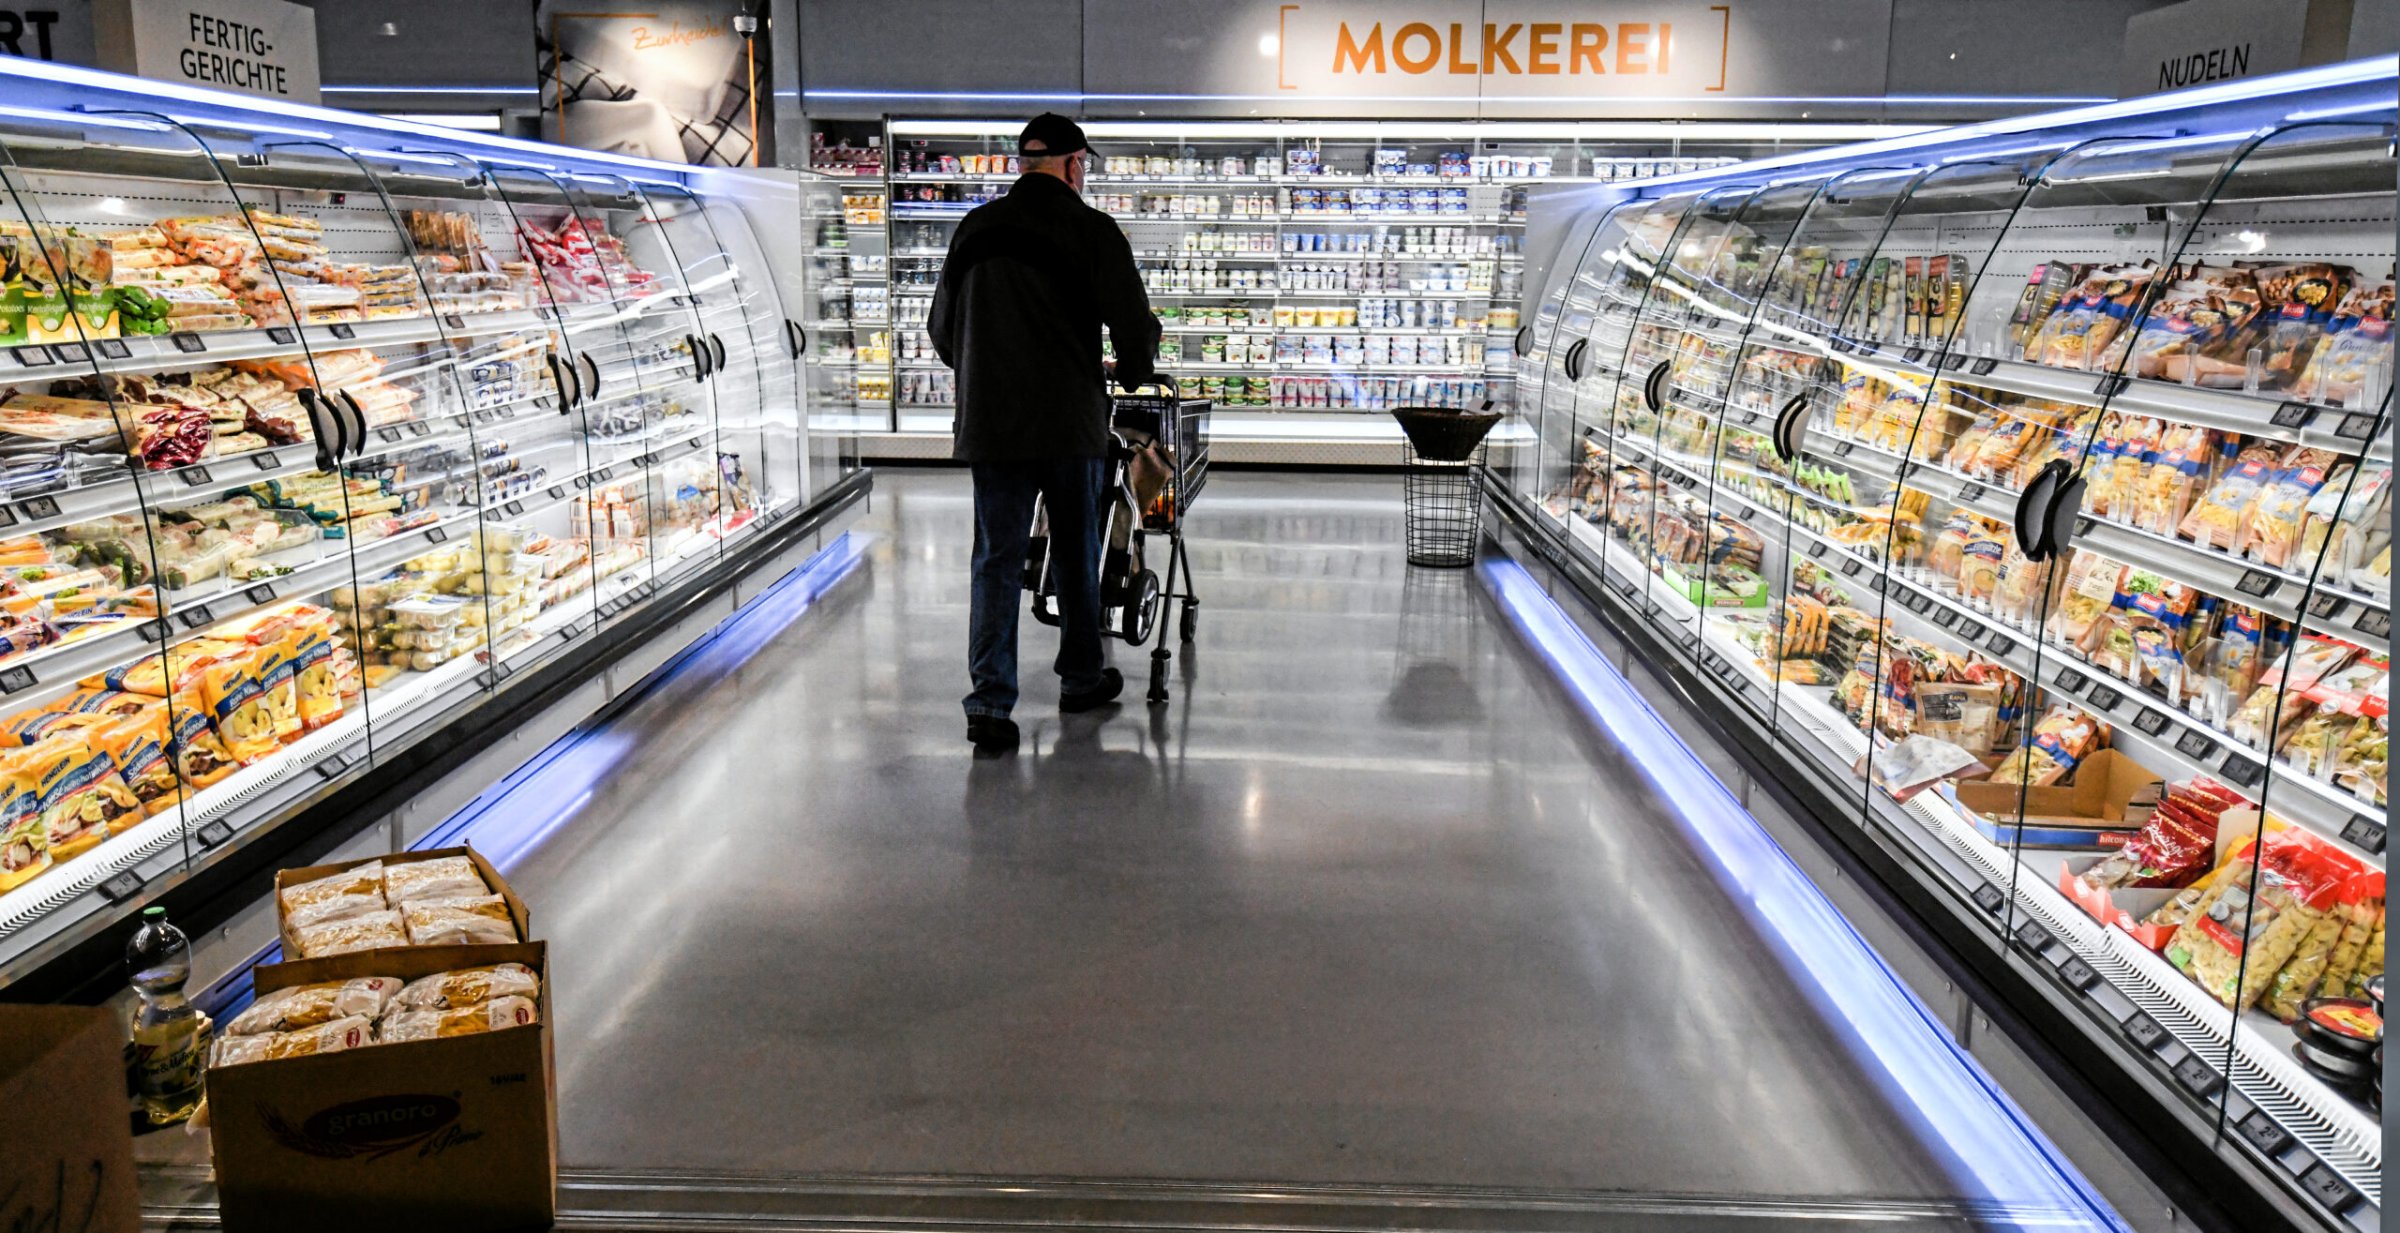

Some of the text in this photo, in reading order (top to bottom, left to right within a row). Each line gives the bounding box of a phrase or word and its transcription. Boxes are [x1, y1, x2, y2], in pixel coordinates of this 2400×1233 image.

[190, 13, 273, 56] FERTIG-
[1332, 22, 1671, 75] MOLKEREI
[180, 49, 288, 94] GERICHTE
[2158, 43, 2250, 90] NUDELN
[41, 755, 71, 787] HENGLEIN
[328, 1103, 438, 1136] granoro
